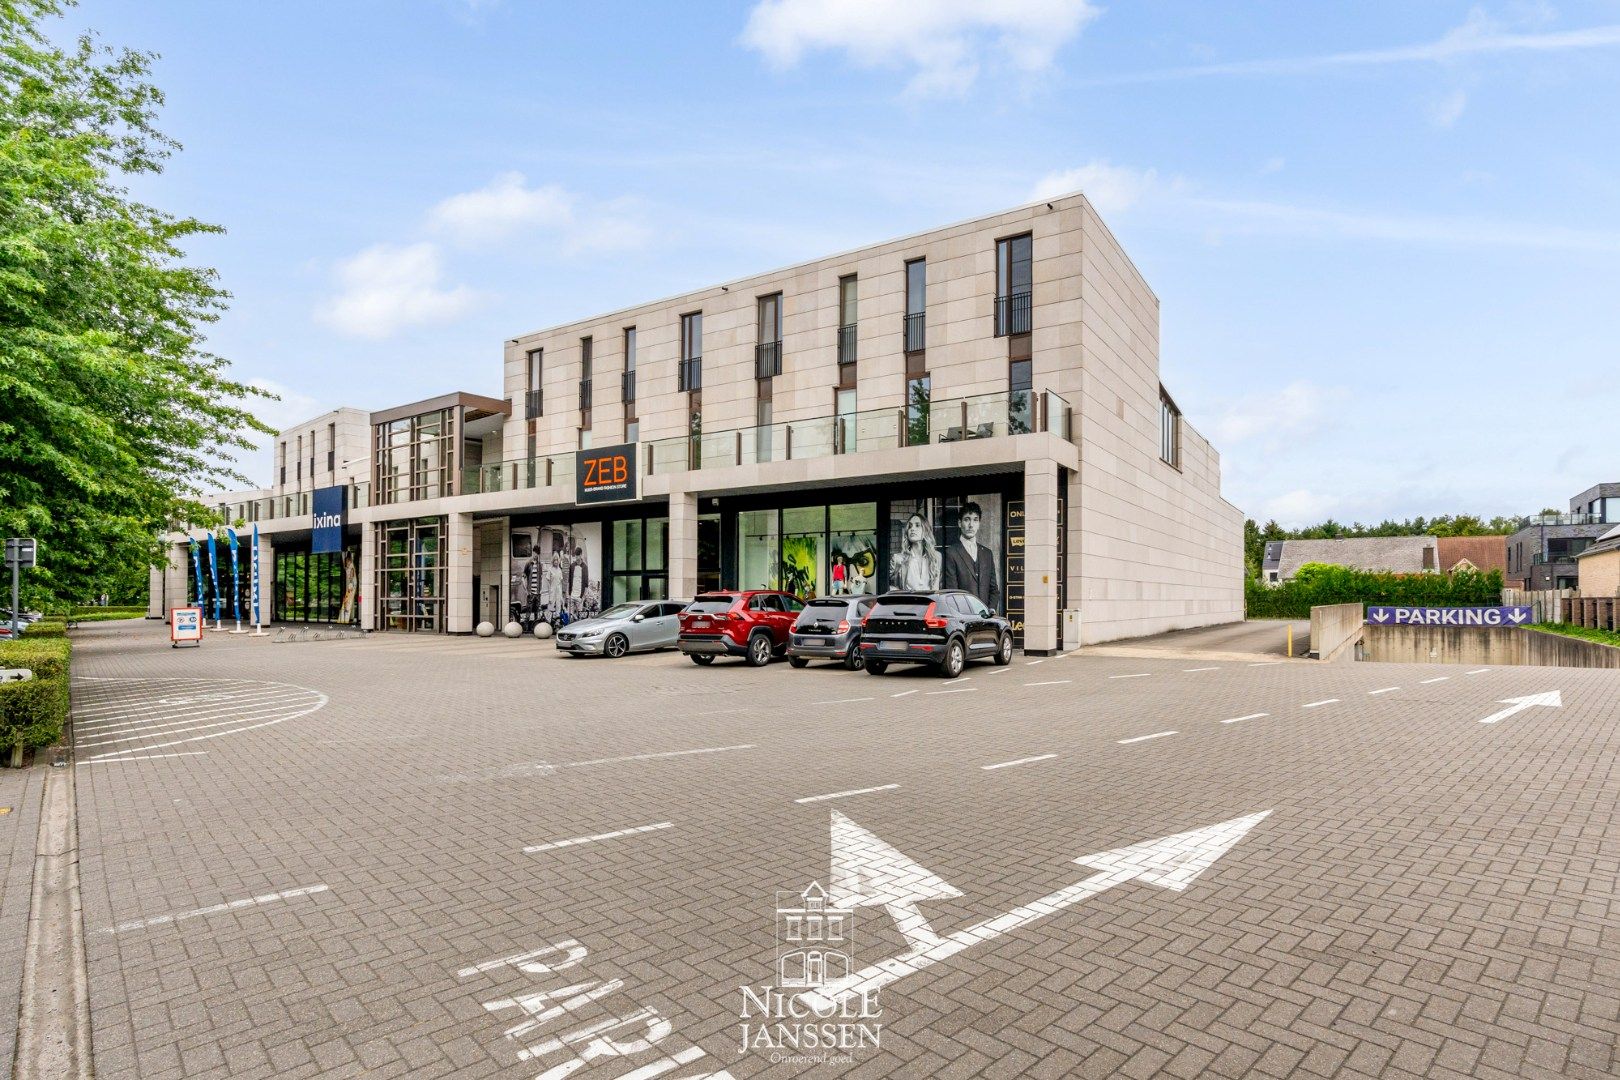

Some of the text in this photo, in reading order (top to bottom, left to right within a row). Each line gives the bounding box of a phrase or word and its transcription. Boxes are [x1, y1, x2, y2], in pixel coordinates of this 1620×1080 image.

[583, 455, 628, 486] ZEB
[313, 511, 341, 529] ixina
[1010, 510, 1025, 518] ONL
[1395, 608, 1501, 625] PARKING
